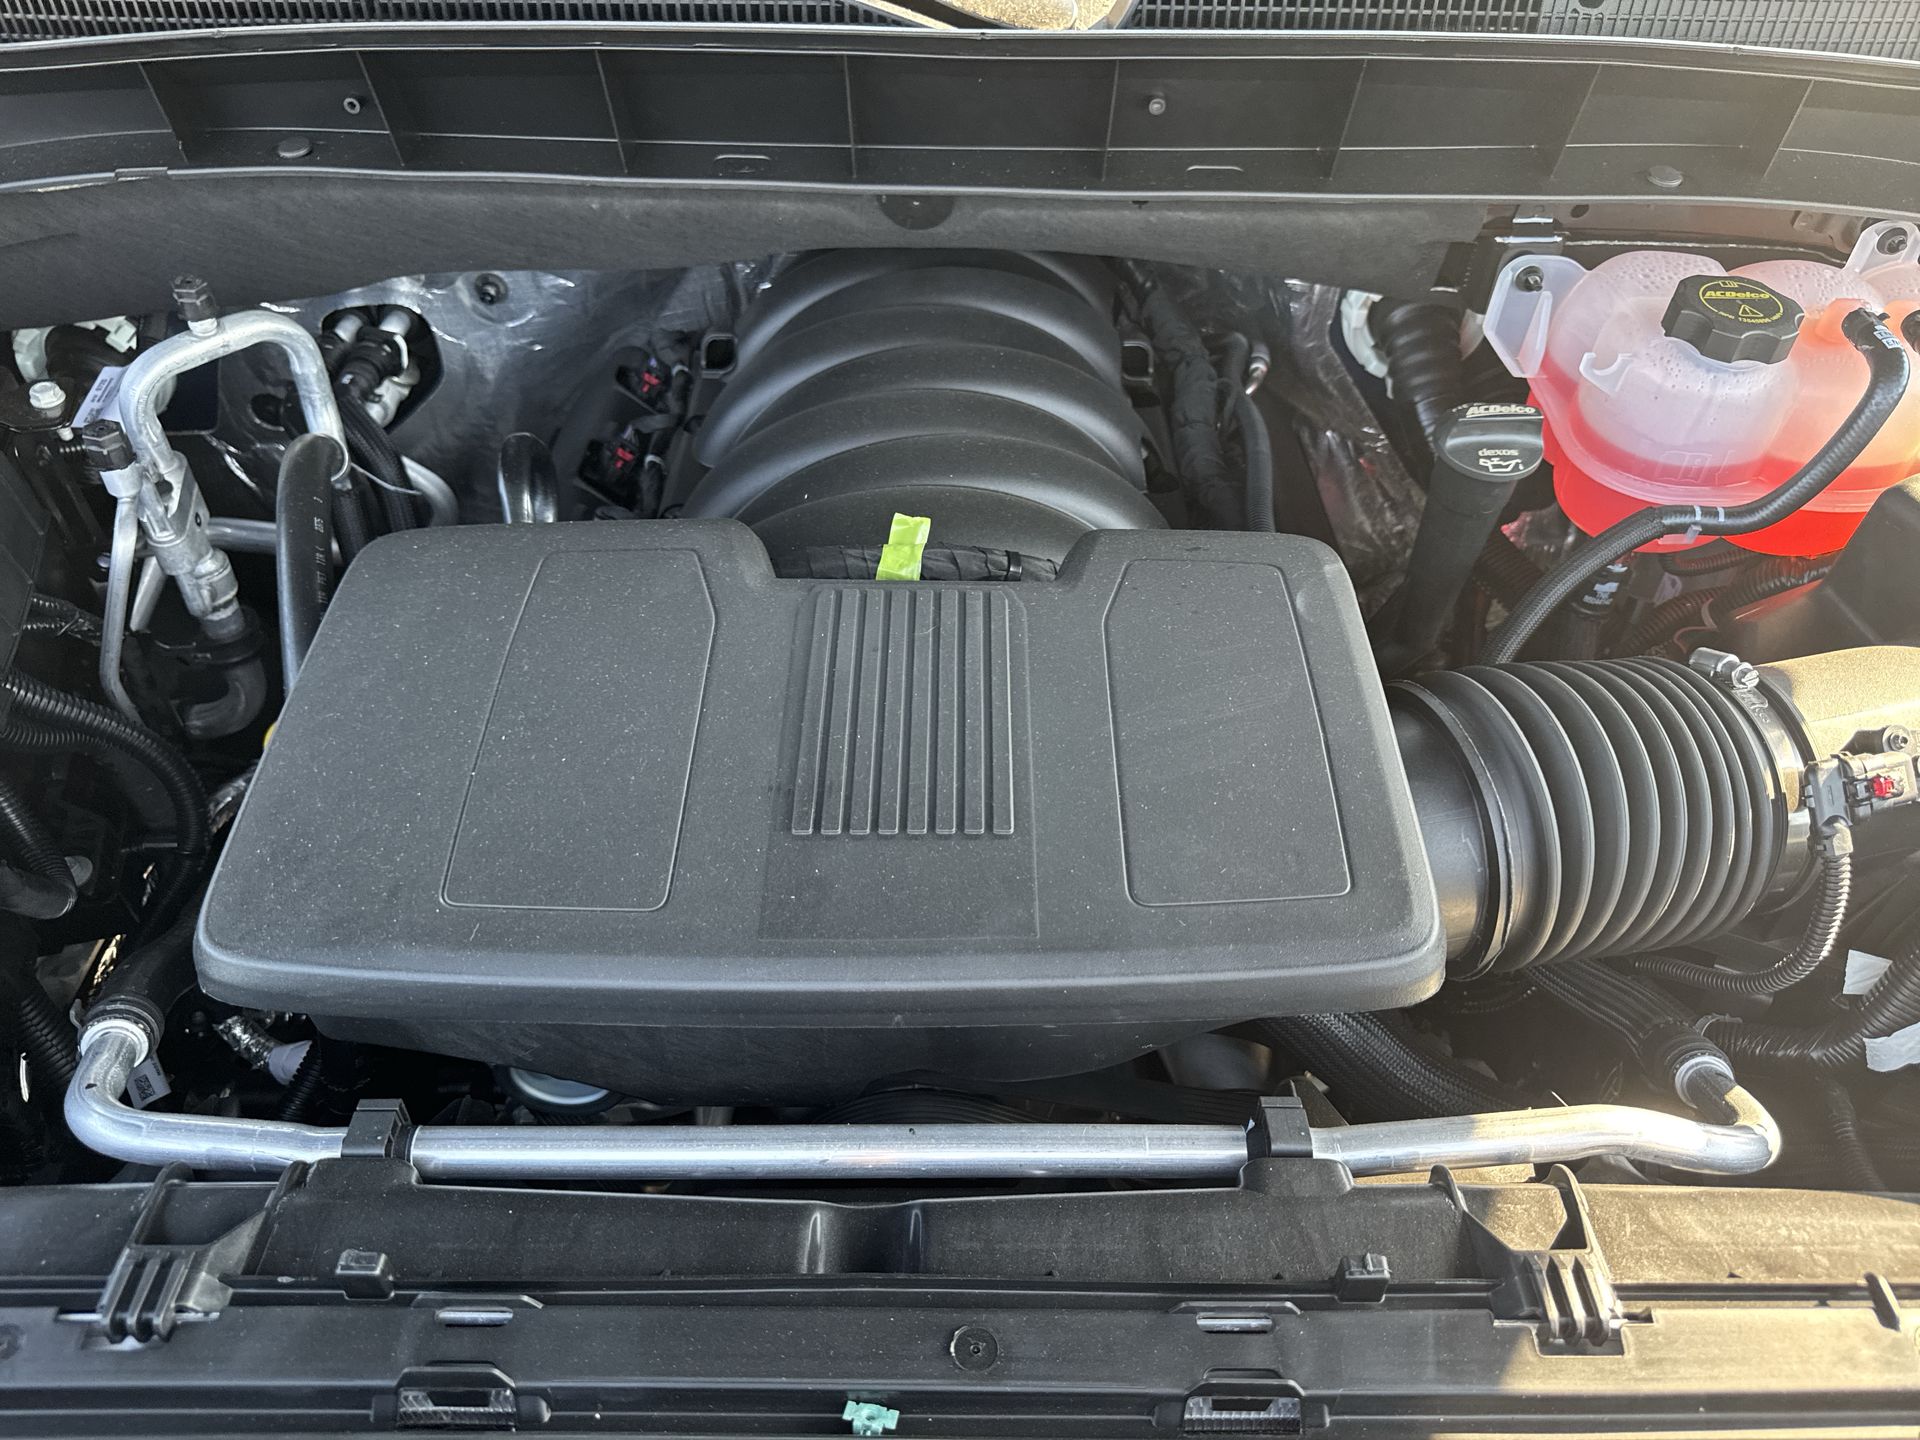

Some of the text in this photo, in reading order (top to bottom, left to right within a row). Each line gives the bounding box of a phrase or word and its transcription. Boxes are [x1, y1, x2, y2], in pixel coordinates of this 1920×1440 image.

[1704, 290, 1770, 299] ACDelco
[1466, 405, 1536, 416] ACDelco
[1478, 448, 1519, 457] dexos
